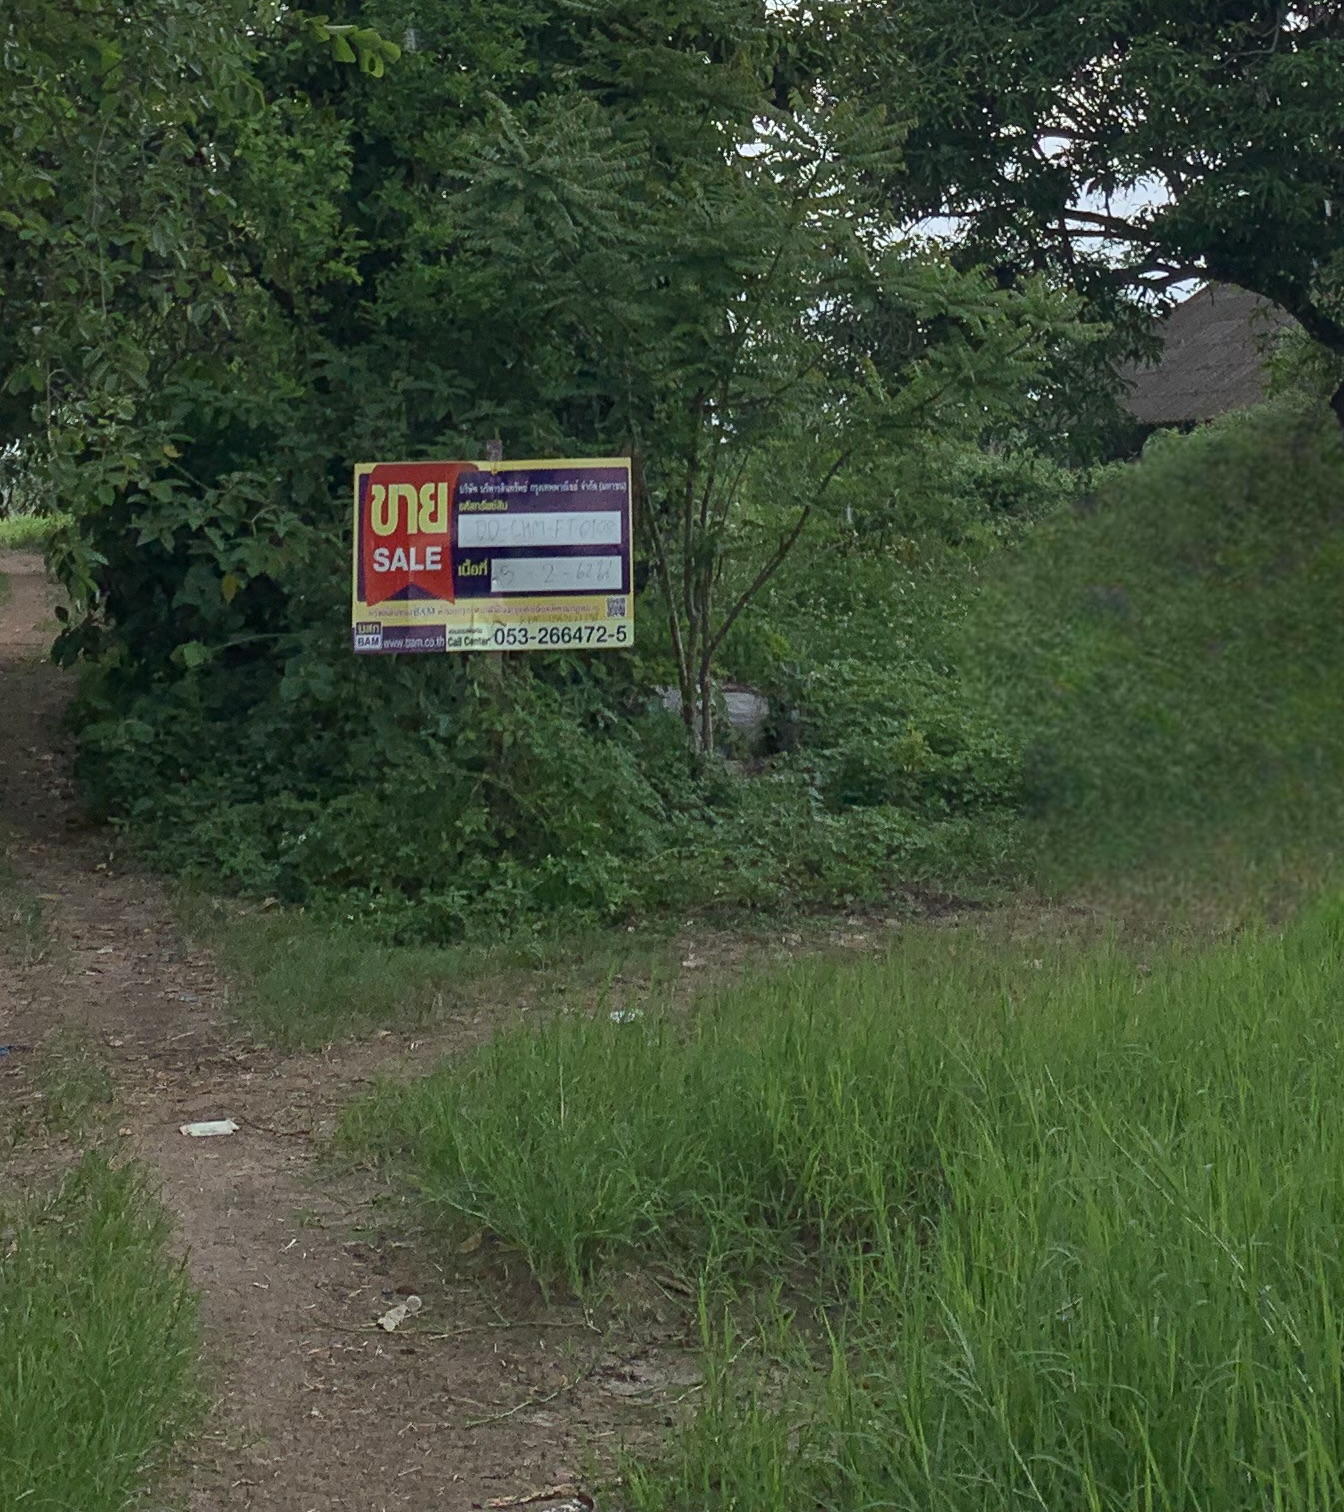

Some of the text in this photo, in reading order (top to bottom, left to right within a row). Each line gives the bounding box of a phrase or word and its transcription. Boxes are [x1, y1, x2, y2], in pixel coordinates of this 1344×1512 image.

[371, 482, 448, 537] ขาย
[373, 546, 442, 573] SALE
[358, 636, 380, 646] BAM
[383, 636, 444, 648] www.bam.co.th
[448, 636, 490, 647] Call Center
[494, 625, 627, 645] 053-266472-5
